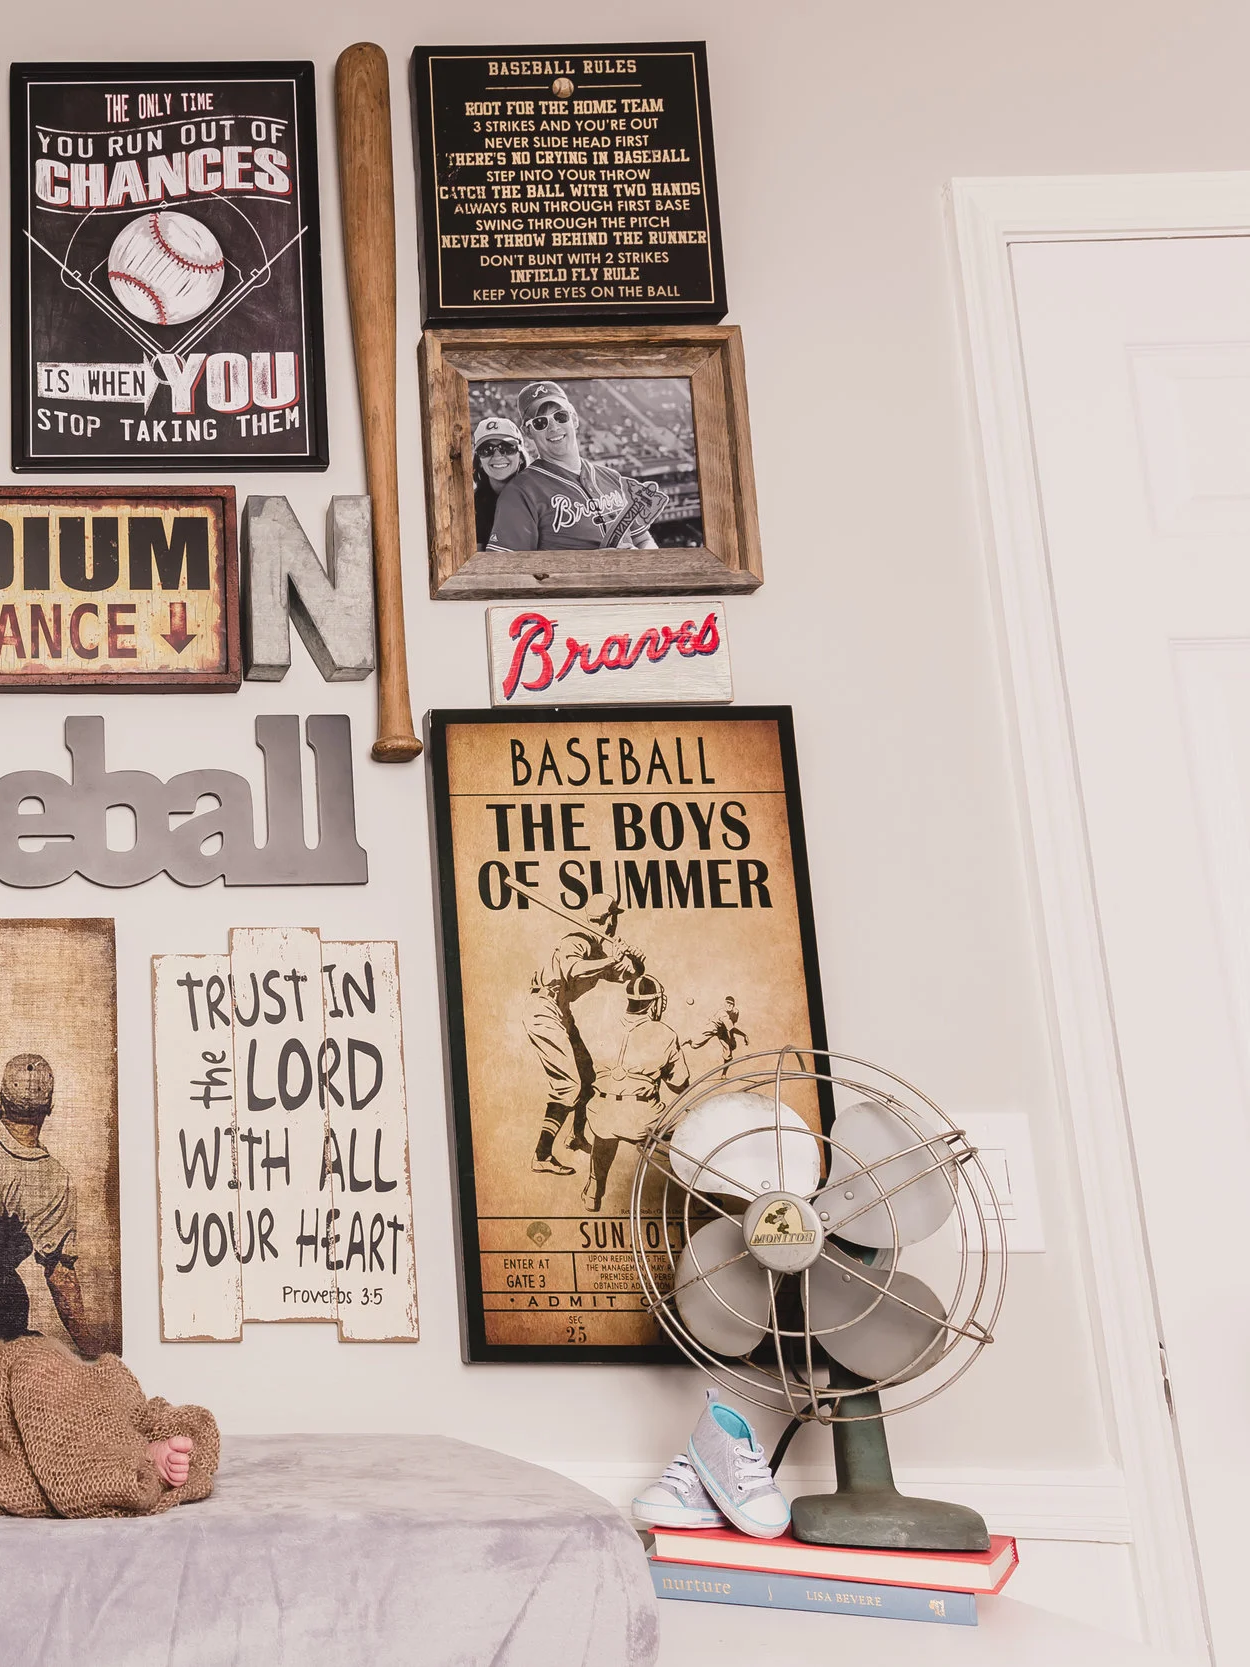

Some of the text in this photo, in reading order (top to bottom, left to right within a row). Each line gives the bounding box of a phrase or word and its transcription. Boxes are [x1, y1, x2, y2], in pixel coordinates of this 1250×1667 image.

[488, 60, 637, 76] BASEBALL RULES
[105, 93, 213, 123] THE ONLY TIME
[465, 99, 664, 116] ROOT FOR THE HOME TEAM
[38, 121, 286, 158] YOU RUN OUT OF
[35, 146, 290, 208] CHANCES
[441, 231, 706, 248] NEVER THROW BEHIND THE RUNNER
[474, 286, 680, 301] KEEP YOUR EYES ON THE BALL
[44, 352, 299, 414] IS WHEN YOU
[38, 408, 300, 442] STOP TAKING THEM
[243, 495, 375, 682] N
[502, 612, 721, 701] Braves
[510, 737, 715, 786] BASEBALL
[486, 801, 750, 852] THE BOYS
[478, 859, 773, 910] OF SUMMER
[177, 961, 376, 1031] TRUST IN
[190, 1038, 383, 1111] the LORD
[179, 1126, 397, 1192] WITH ALL
[175, 1208, 404, 1274] YOUR HEART
[753, 1233, 812, 1243] MONITOR
[503, 1258, 549, 1270] ENTER AT
[283, 1286, 383, 1305] Proverbs 3:5
[506, 1274, 545, 1288] GATE 3
[527, 1295, 616, 1307] ADMIT
[568, 1316, 583, 1324] SEC
[567, 1328, 587, 1343] 25
[662, 1578, 732, 1594] nurture
[806, 1591, 882, 1607] LISA BEVERE
